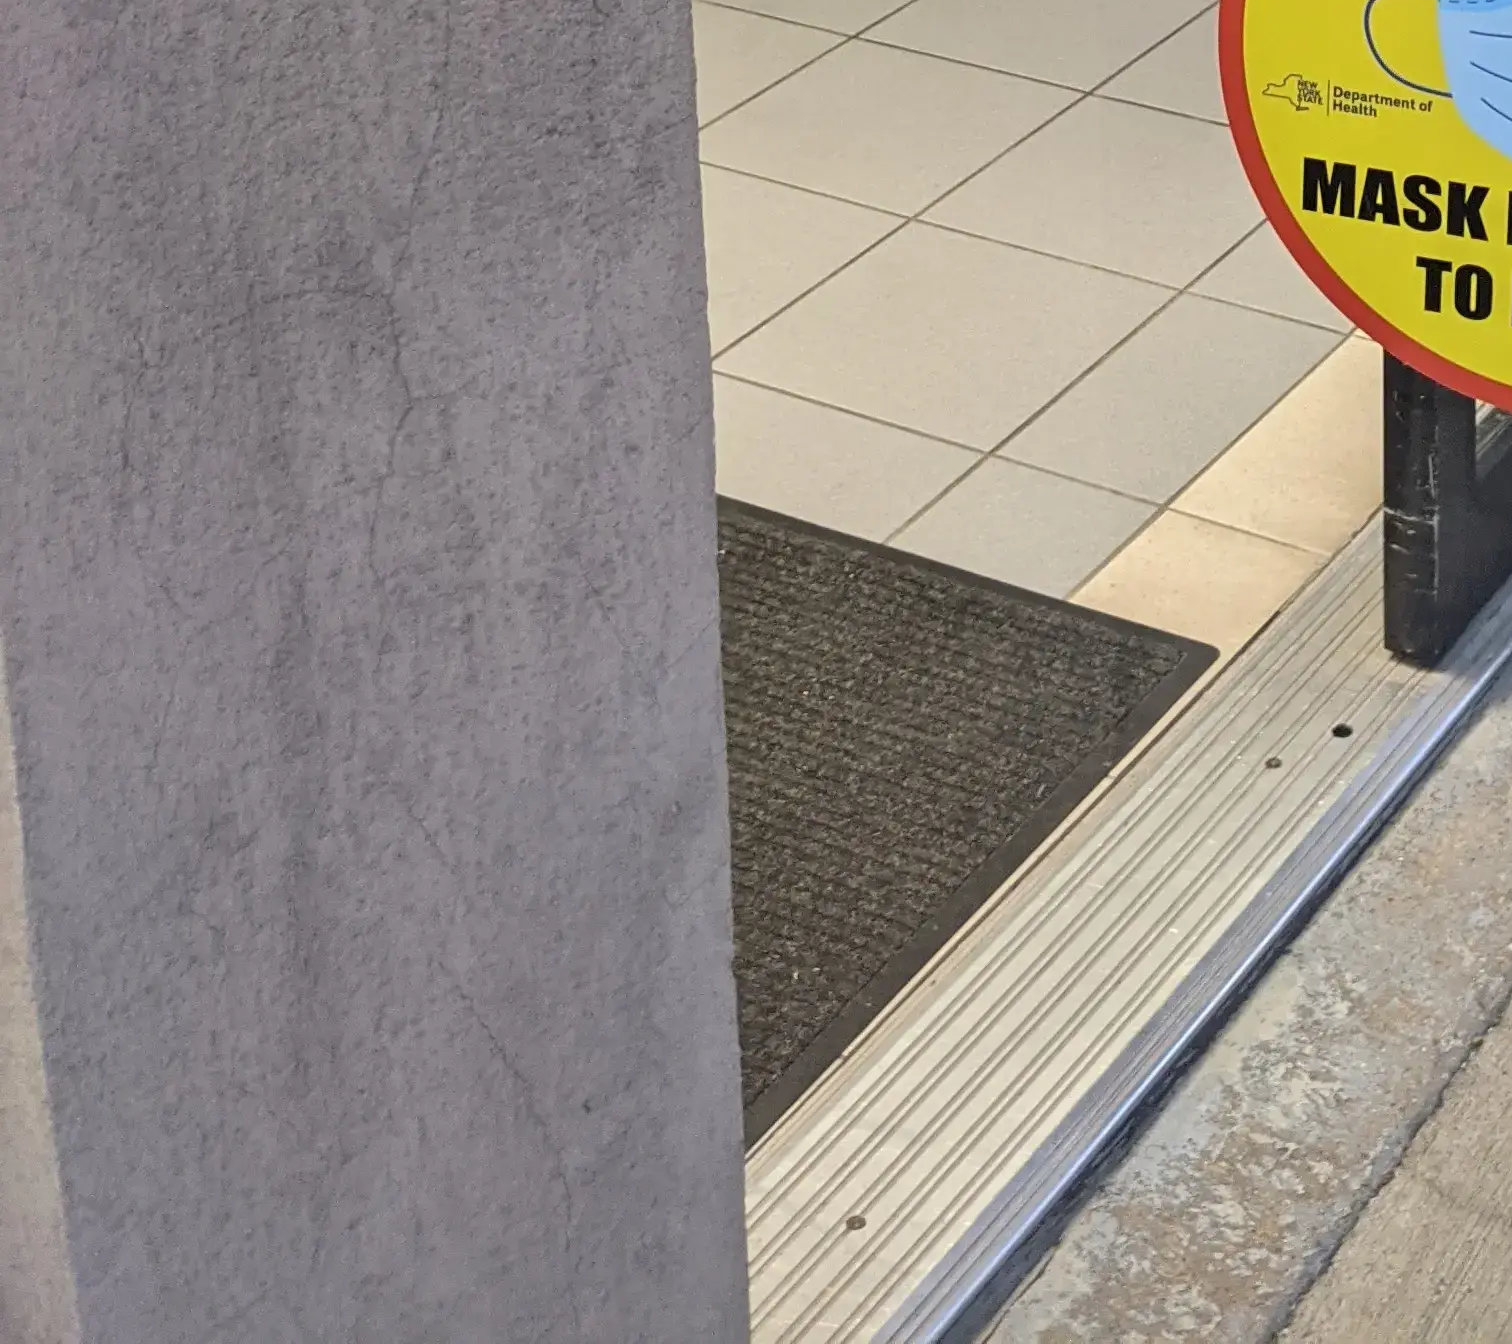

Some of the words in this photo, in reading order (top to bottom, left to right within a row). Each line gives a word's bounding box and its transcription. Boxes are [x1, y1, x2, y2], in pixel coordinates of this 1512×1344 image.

[1297, 79, 1318, 89] NEW
[1333, 86, 1416, 110] Department
[1419, 100, 1433, 112] of
[1333, 99, 1378, 117] Health
[1302, 156, 1490, 242] MASK
[1415, 256, 1494, 321] TO
